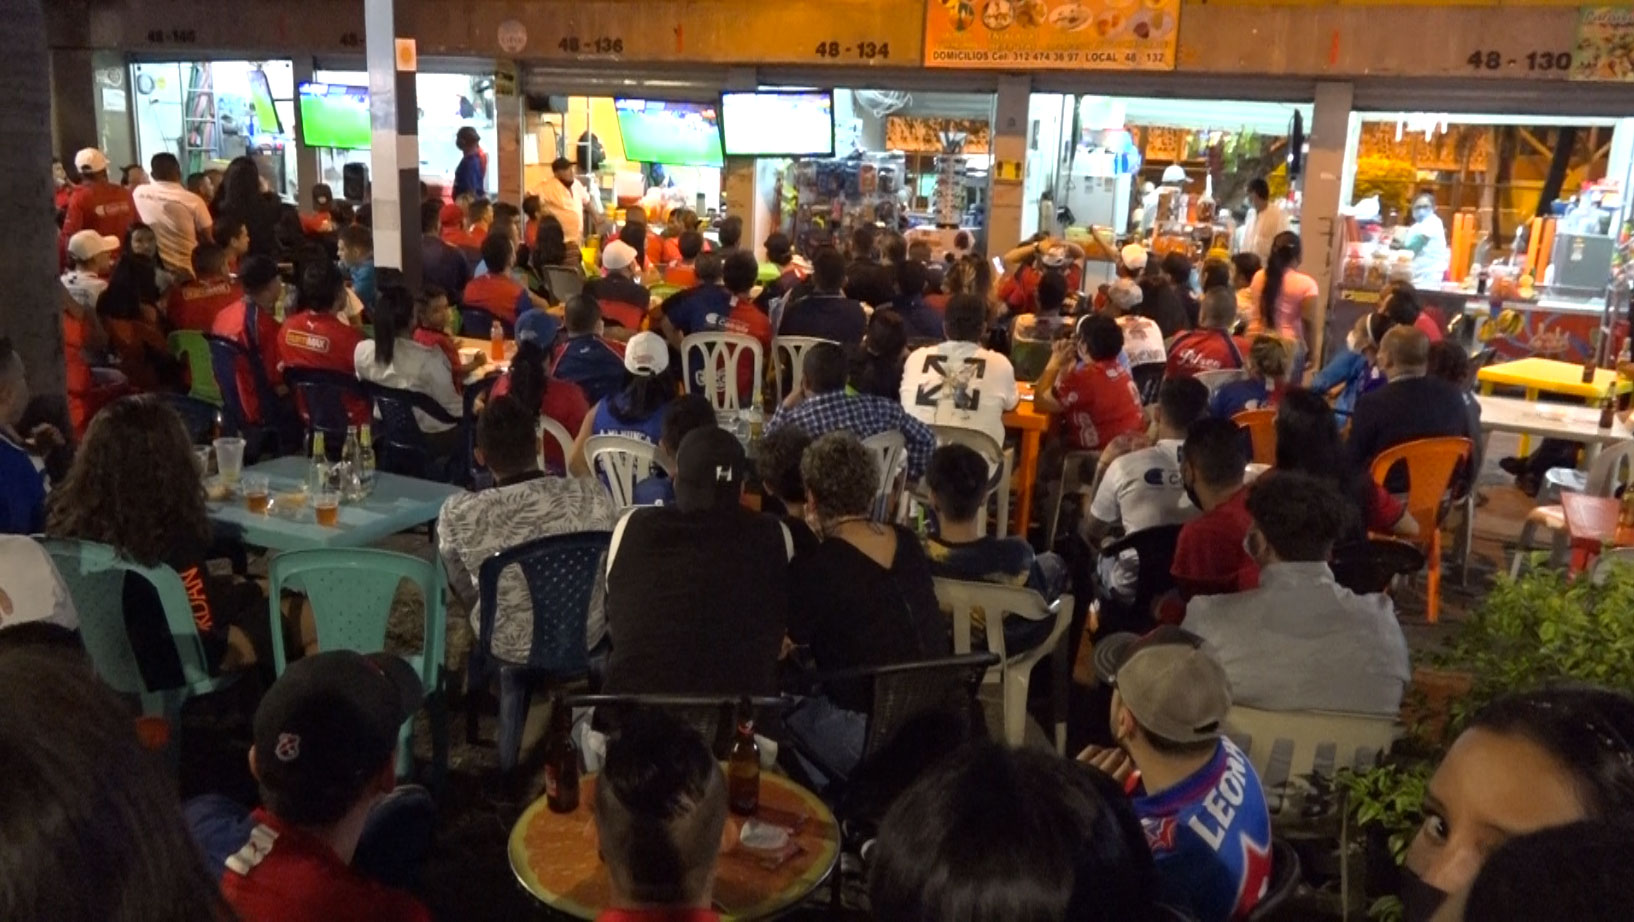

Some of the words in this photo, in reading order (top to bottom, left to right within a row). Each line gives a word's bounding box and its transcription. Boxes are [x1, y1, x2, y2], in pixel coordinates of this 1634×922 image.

[558, 37, 579, 52] 48
[594, 38, 624, 53] 136
[815, 41, 840, 58] 48
[857, 42, 890, 59] 134
[932, 51, 989, 62] DOMICILIOS
[1013, 52, 1029, 62] 312
[1032, 52, 1050, 62] 474
[1067, 52, 1080, 62] 97
[1085, 53, 1119, 62] LOCAL
[1146, 52, 1165, 63] 132
[1467, 50, 1501, 70] 48
[1526, 51, 1573, 71] 130
[716, 466, 733, 482] H
